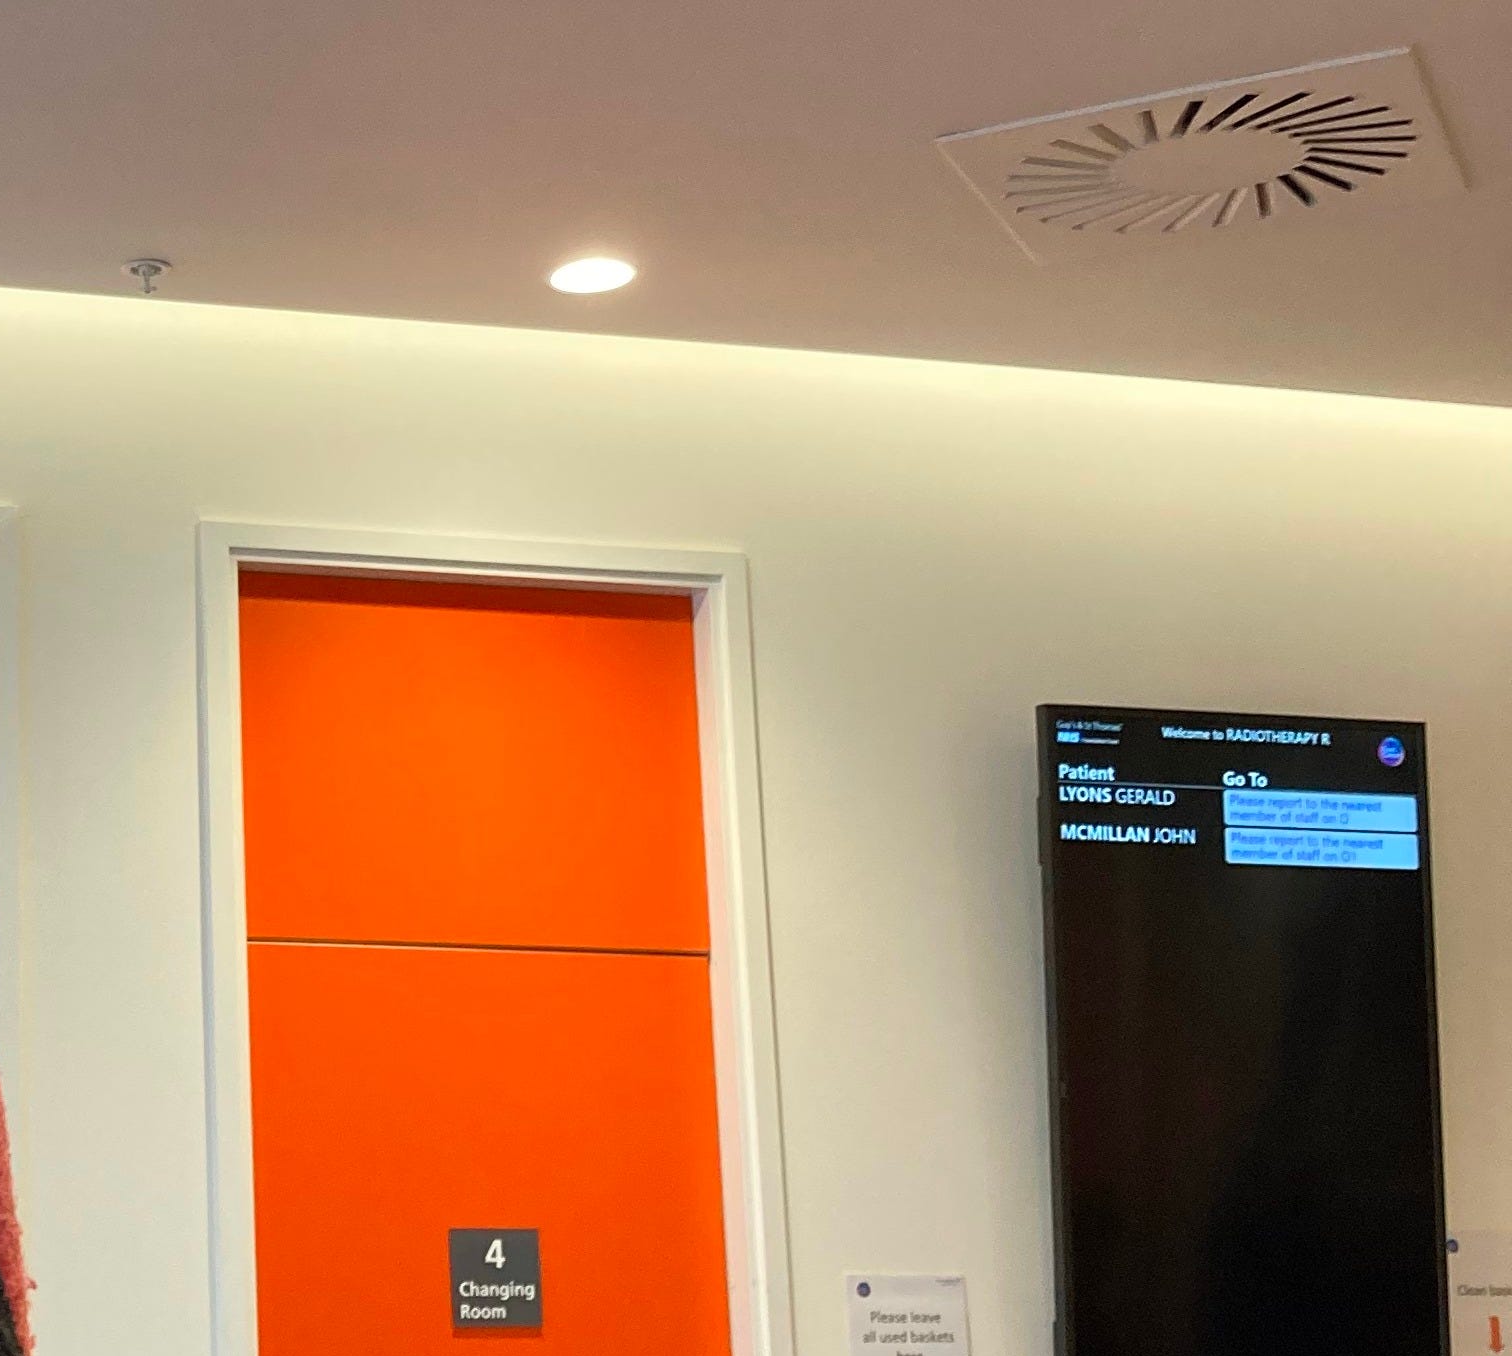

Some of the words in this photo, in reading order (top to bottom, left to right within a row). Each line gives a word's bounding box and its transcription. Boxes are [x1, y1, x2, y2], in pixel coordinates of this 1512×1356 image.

[1161, 726, 1210, 740] Welcome
[1212, 729, 1224, 740] to
[1226, 728, 1318, 745] RADIOTHERAPY
[1058, 764, 1114, 781] Patient
[1222, 770, 1246, 786] Go
[1248, 772, 1268, 788] To
[1059, 786, 1112, 803] LYONS
[1115, 788, 1176, 806] GERALD
[1230, 794, 1264, 807] Please
[1269, 798, 1302, 810] report
[1306, 800, 1317, 809] to
[1320, 800, 1337, 810] the
[1342, 802, 1382, 812] nearest
[1230, 810, 1276, 821] member
[1280, 812, 1290, 822] of
[1295, 812, 1318, 823] staff
[1060, 824, 1150, 843] MCMILLAN
[1153, 827, 1196, 845] JOHN
[1231, 832, 1266, 845] Please
[1270, 836, 1303, 847] report
[1307, 836, 1318, 846] to
[1322, 837, 1339, 847] the
[1343, 839, 1383, 849] nearest
[1231, 848, 1277, 859] member
[1282, 850, 1292, 860] of
[1296, 850, 1320, 861] staff
[485, 1238, 506, 1269] 4
[459, 1280, 535, 1300] Changing
[1457, 1285, 1487, 1296] Clean
[460, 1304, 506, 1319] Room
[870, 1310, 907, 1324] Please
[910, 1312, 941, 1324] leave
[863, 1331, 876, 1343] all
[879, 1331, 907, 1343] used
[910, 1330, 954, 1343] baskets
